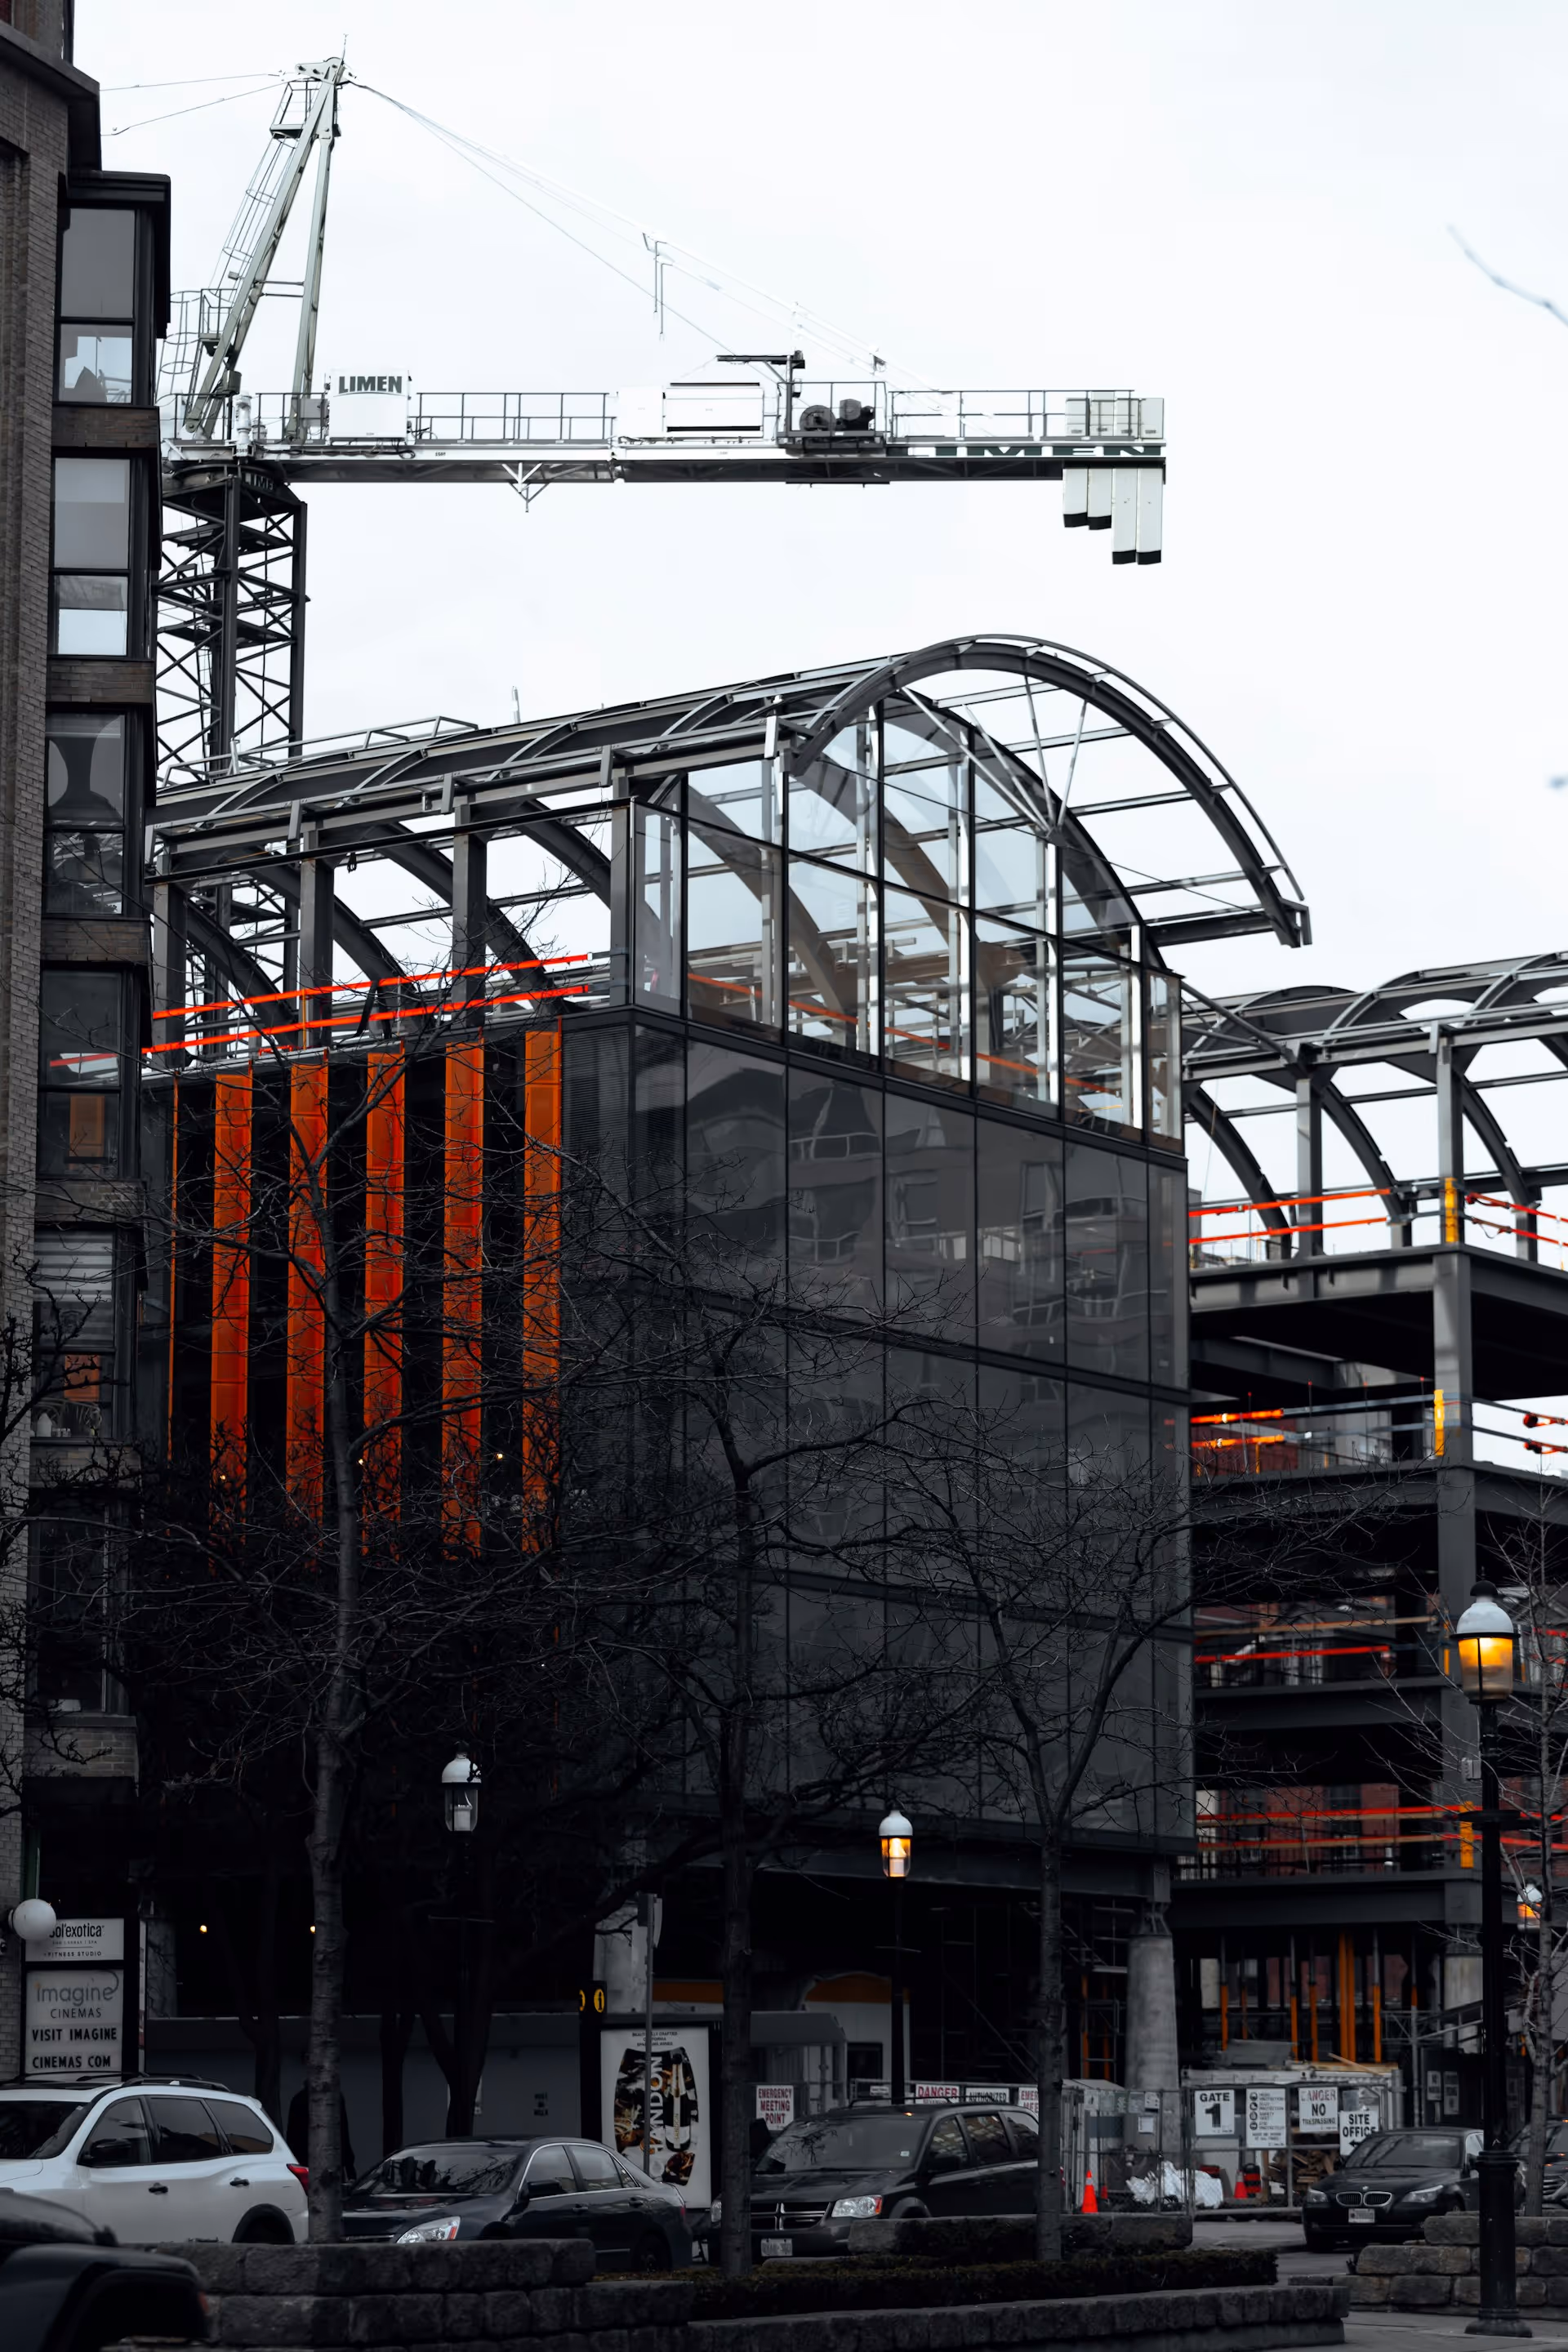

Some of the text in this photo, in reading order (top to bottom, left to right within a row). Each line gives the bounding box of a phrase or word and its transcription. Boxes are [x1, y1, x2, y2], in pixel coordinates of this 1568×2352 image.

[338, 376, 403, 394] LIMEN
[35, 1971, 120, 2007] imagine
[50, 2007, 102, 2020] CINEMAS
[32, 2028, 118, 2042] VISIT IMAGINE
[32, 2055, 111, 2069] CINEMAS COM
[758, 2087, 792, 2099] EMERGENCY
[917, 2086, 959, 2100] DANGER
[1200, 2092, 1230, 2102] GATE
[760, 2100, 791, 2111] MEETING
[1312, 2103, 1326, 2116] NO
[764, 2113, 786, 2124] POINT
[1205, 2103, 1221, 2128] 1
[1302, 2117, 1336, 2125] TRESPASSING
[1348, 2114, 1370, 2125] SITE
